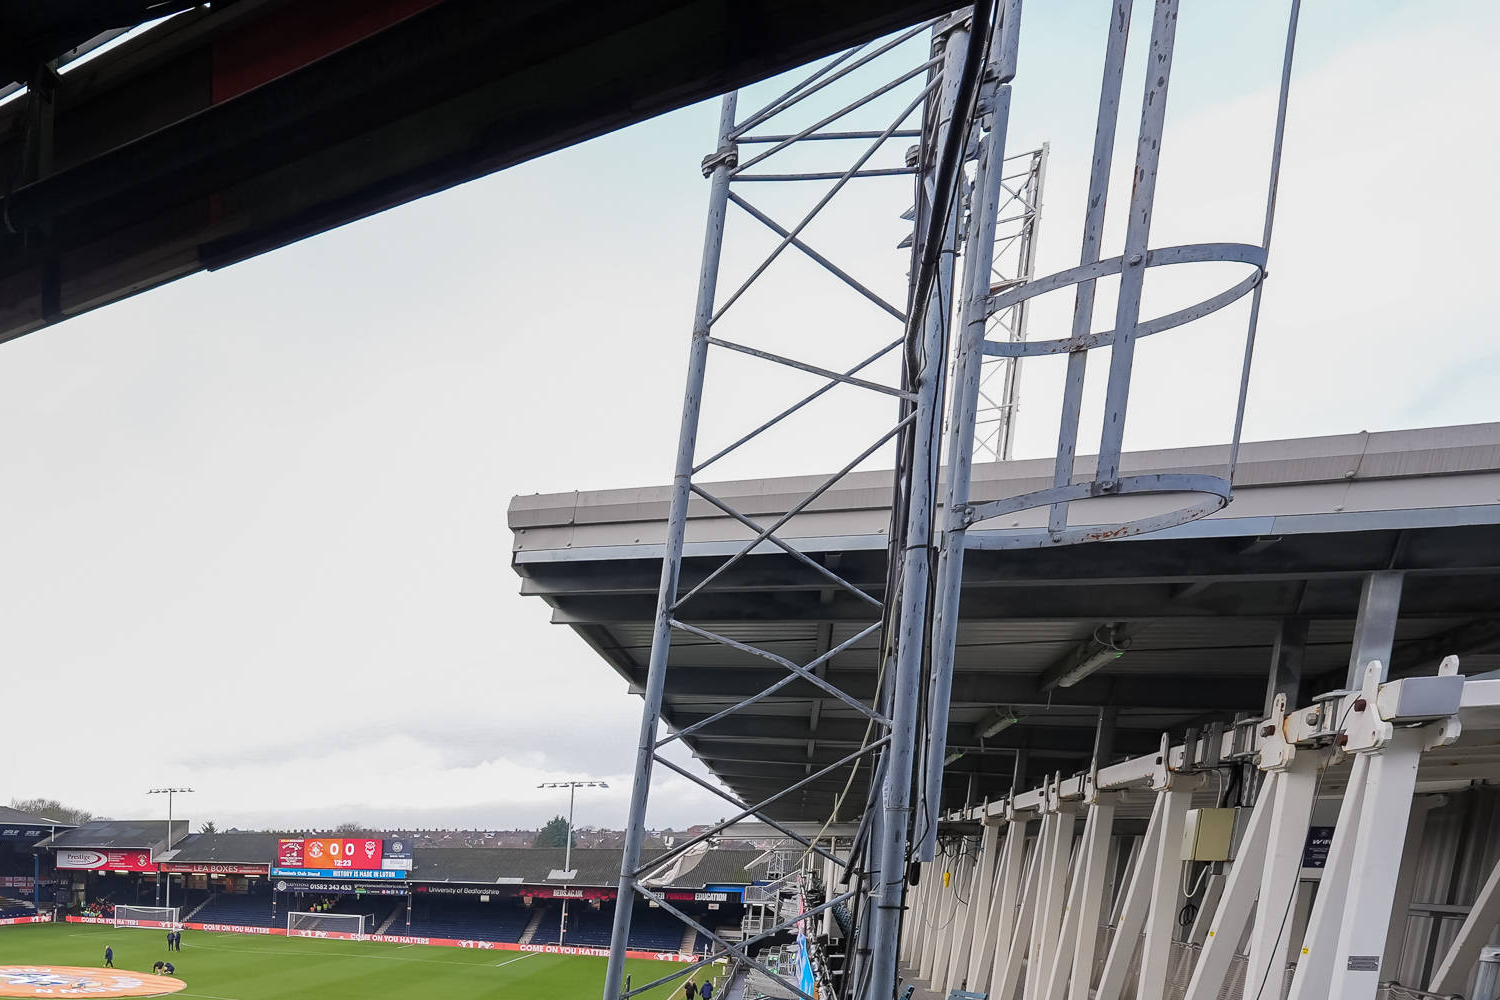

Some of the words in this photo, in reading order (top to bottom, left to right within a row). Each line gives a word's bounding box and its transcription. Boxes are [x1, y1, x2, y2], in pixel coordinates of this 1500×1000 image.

[330, 843, 339, 855] 0
[345, 843, 354, 856] 0
[695, 893, 727, 901] EDUCATION
[203, 923, 221, 931] COME
[246, 926, 270, 934] HATTERS
[400, 936, 429, 944] HATTERS
[520, 944, 543, 952] COME
[545, 946, 558, 954] ON
[559, 946, 577, 955] YOU
